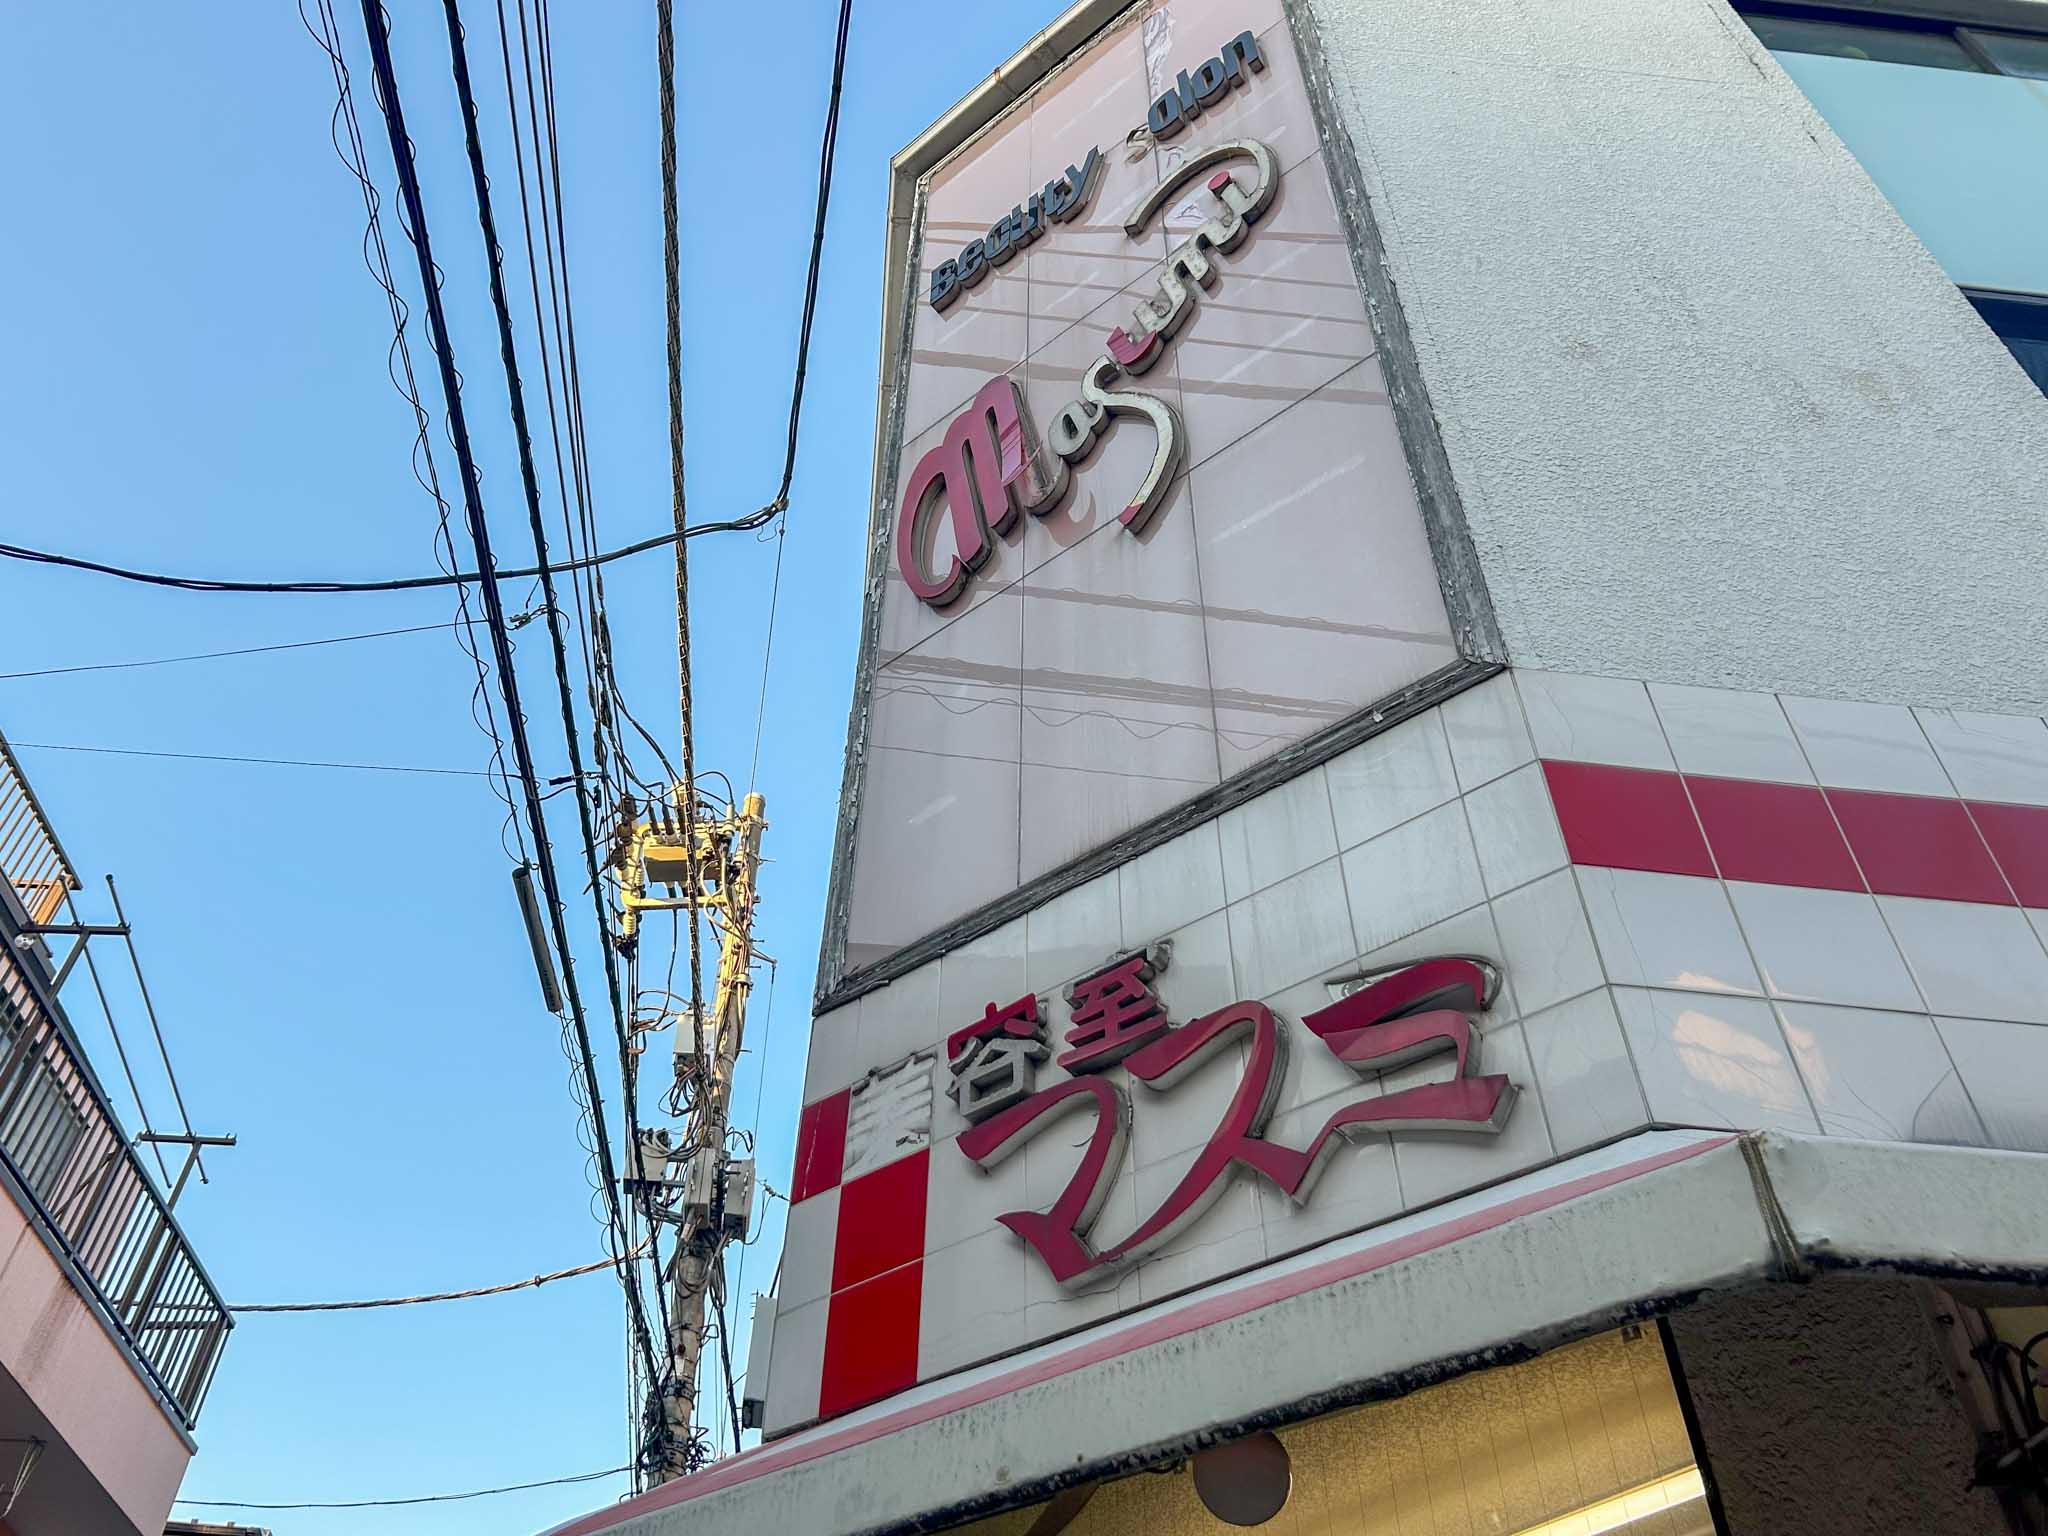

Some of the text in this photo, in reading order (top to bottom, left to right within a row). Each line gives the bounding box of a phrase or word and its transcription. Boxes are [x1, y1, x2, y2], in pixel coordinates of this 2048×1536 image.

[930, 144, 1104, 313] Beauty
[955, 955, 1522, 1292] マスミ
